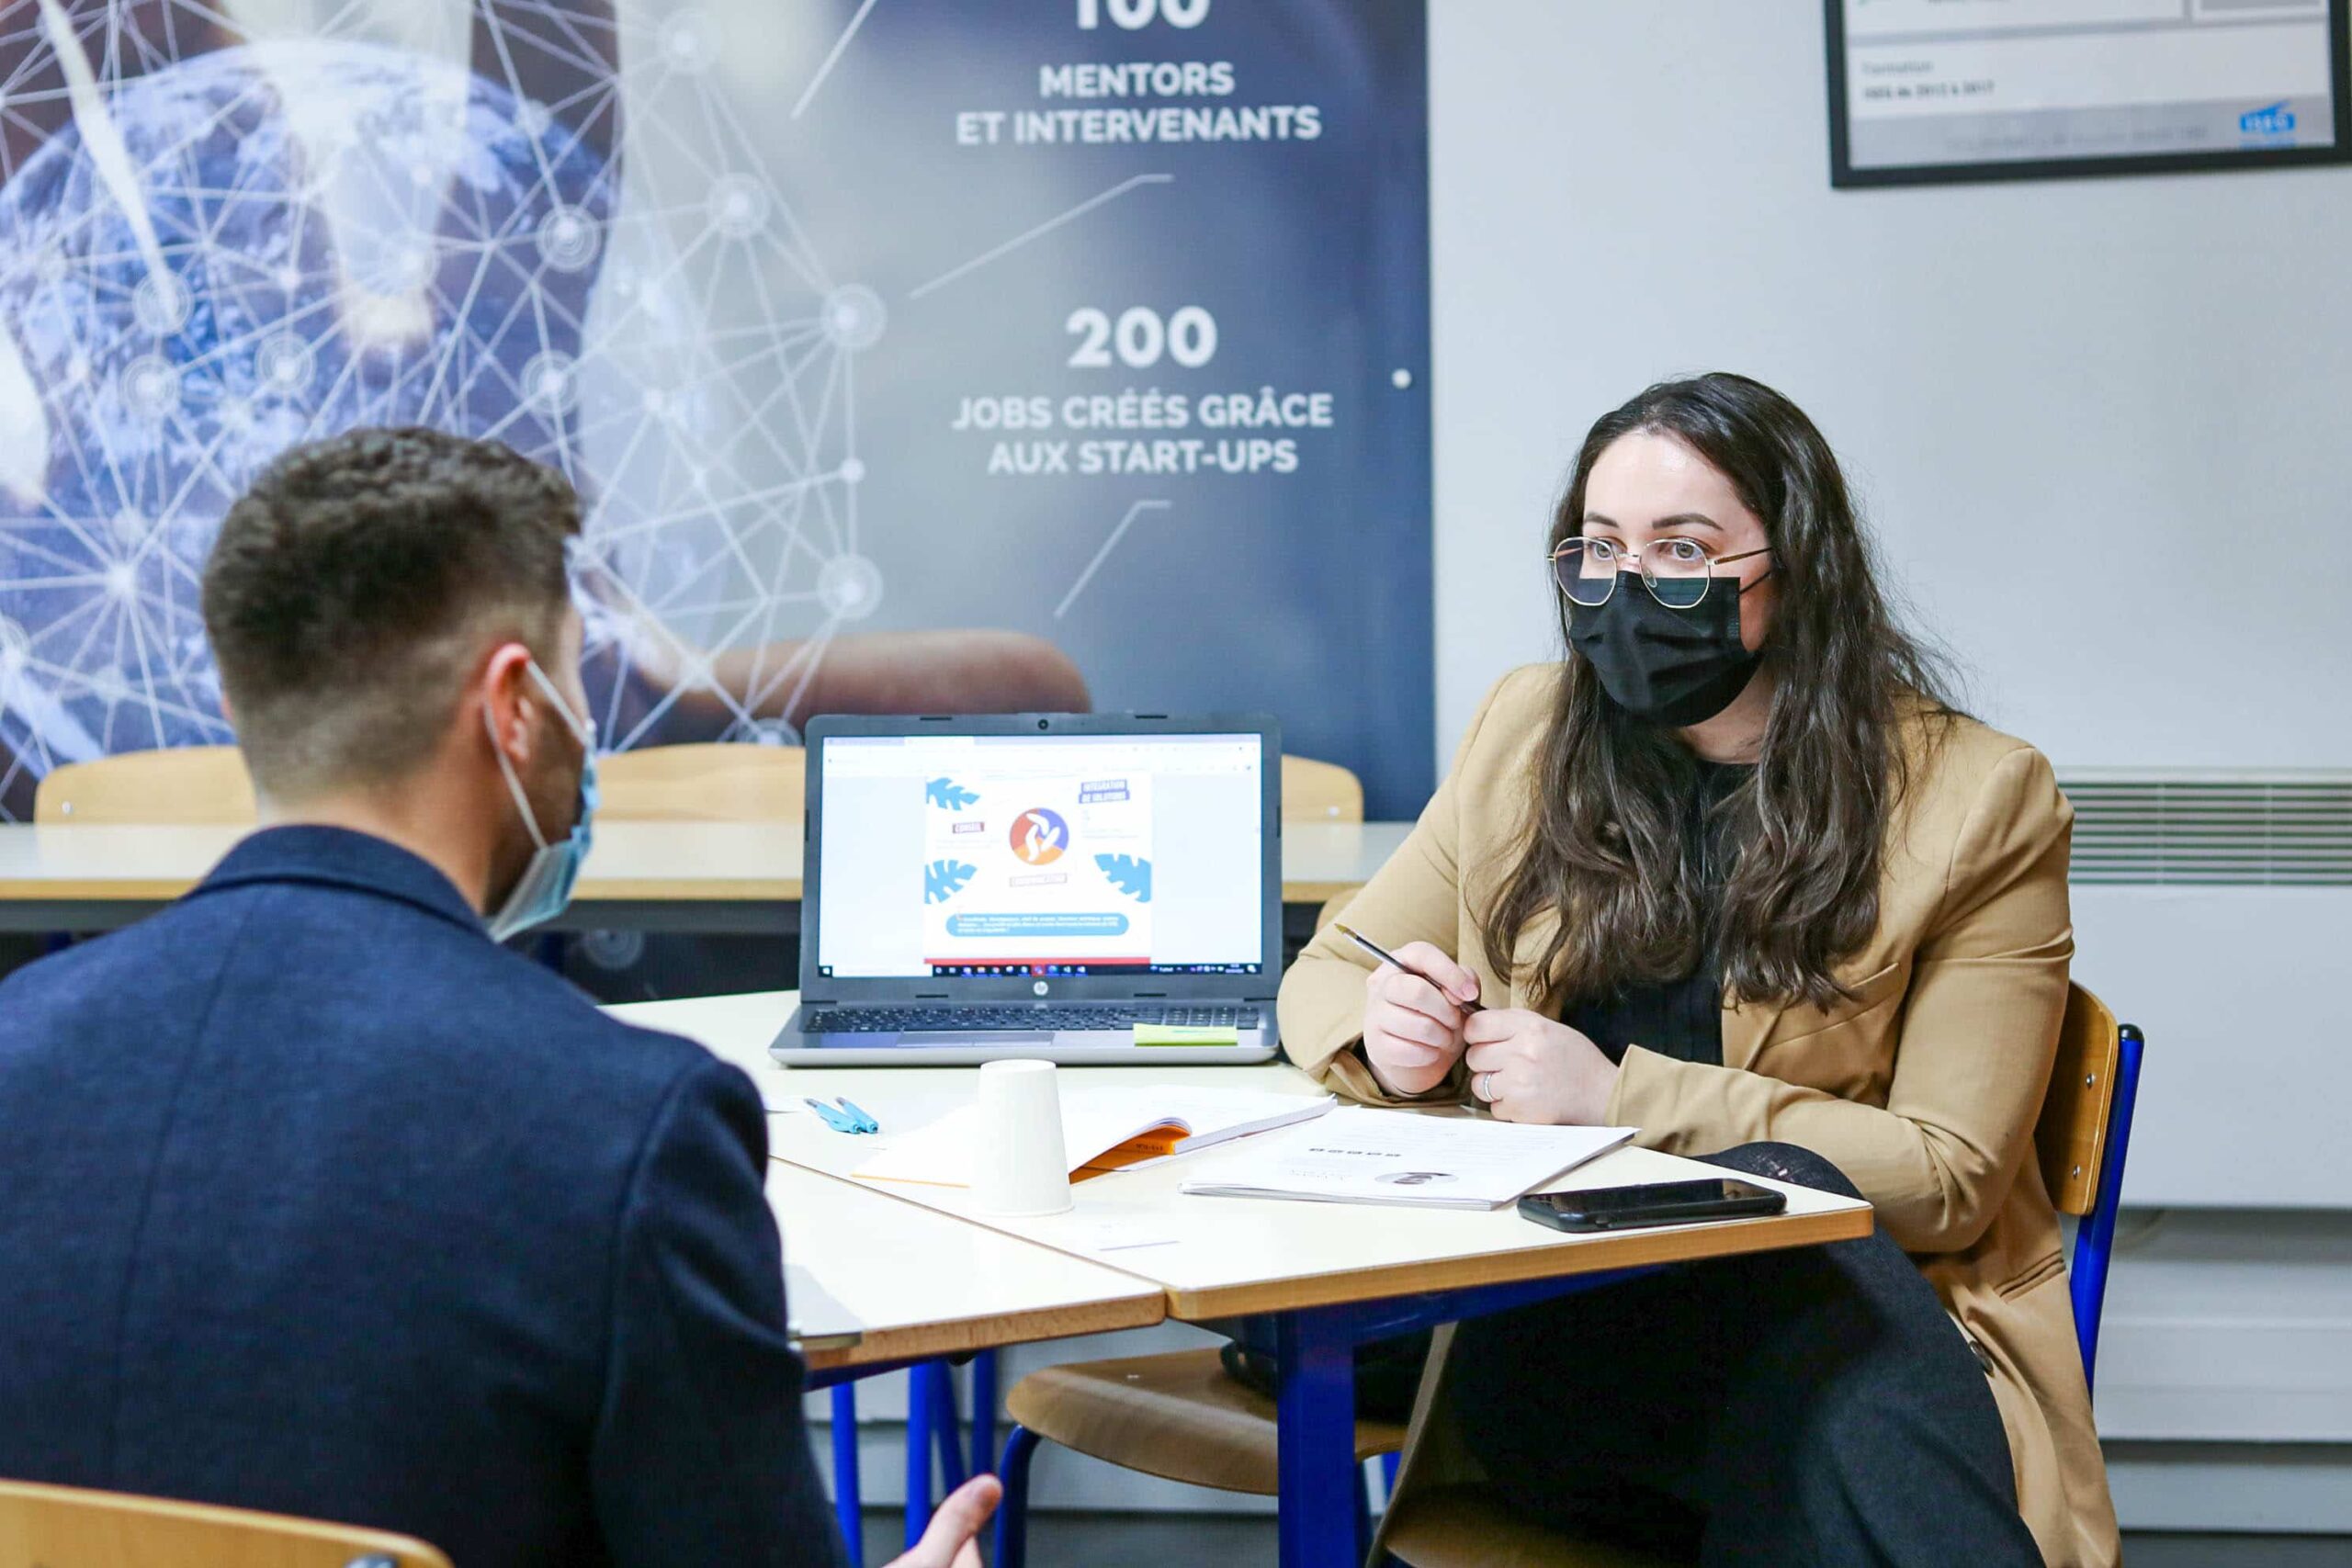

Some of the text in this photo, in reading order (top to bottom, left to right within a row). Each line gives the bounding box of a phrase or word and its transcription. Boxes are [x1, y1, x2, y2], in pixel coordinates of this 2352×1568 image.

[1040, 62, 1235, 96] MENTORS
[956, 106, 1322, 144] ET INTERVENANTS
[1066, 307, 1217, 367] 200
[952, 386, 1333, 430] JOBS CRÉÉS GRÂCE
[988, 440, 1298, 474] AUX START-UPS
